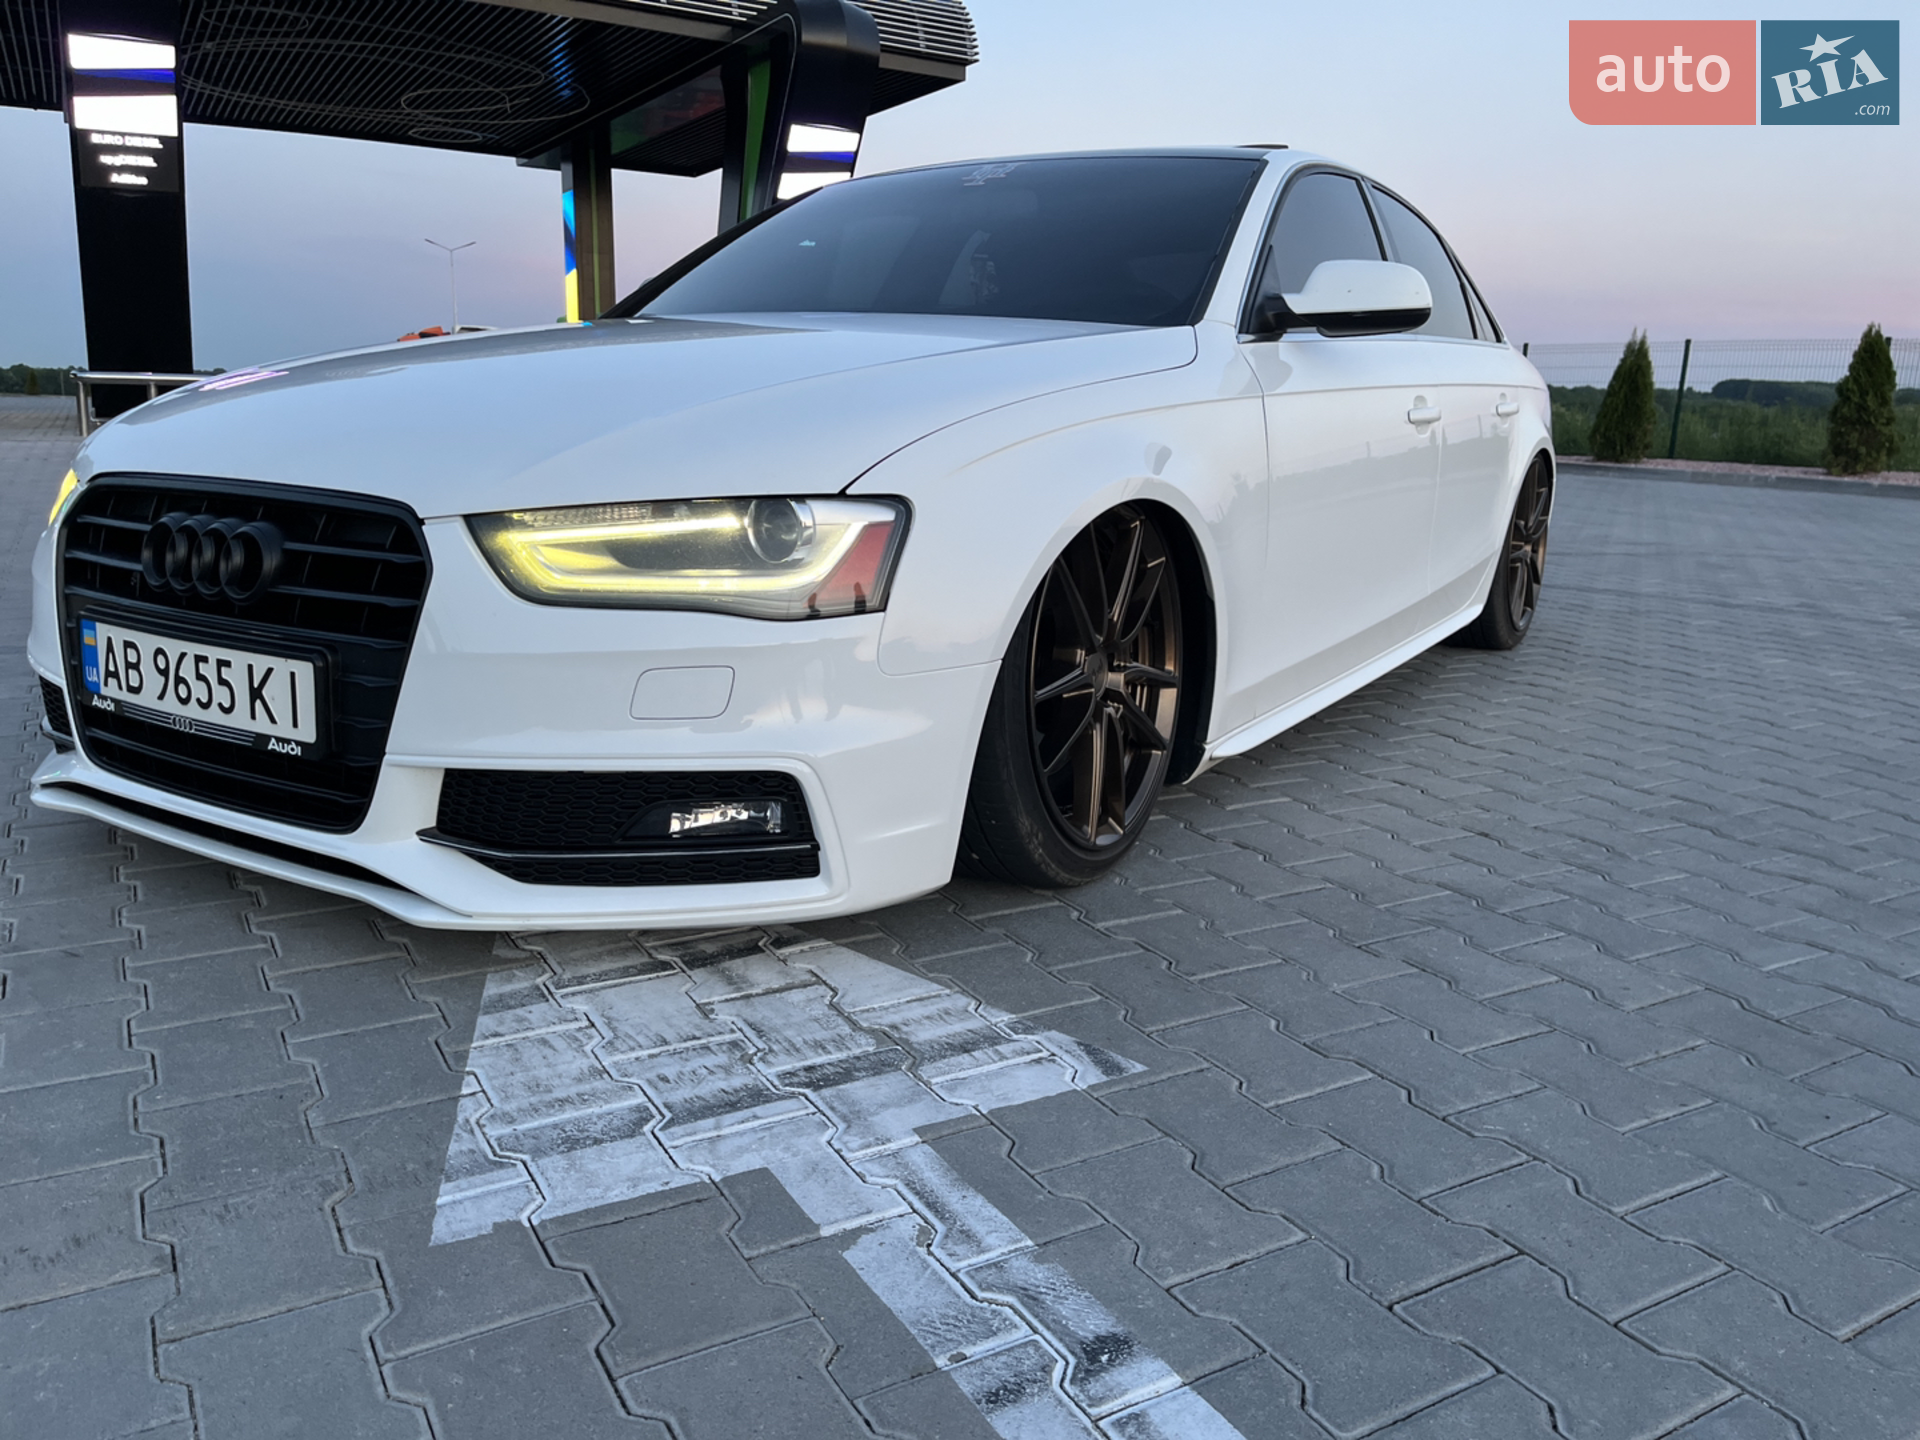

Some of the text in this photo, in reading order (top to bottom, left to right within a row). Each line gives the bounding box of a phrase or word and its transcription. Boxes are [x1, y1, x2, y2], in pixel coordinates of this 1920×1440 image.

[91, 133, 123, 145] EURO
[85, 666, 99, 683] UA
[103, 635, 299, 729] AB 9655 KI
[92, 695, 115, 712] Audi
[267, 737, 302, 757] Audi
